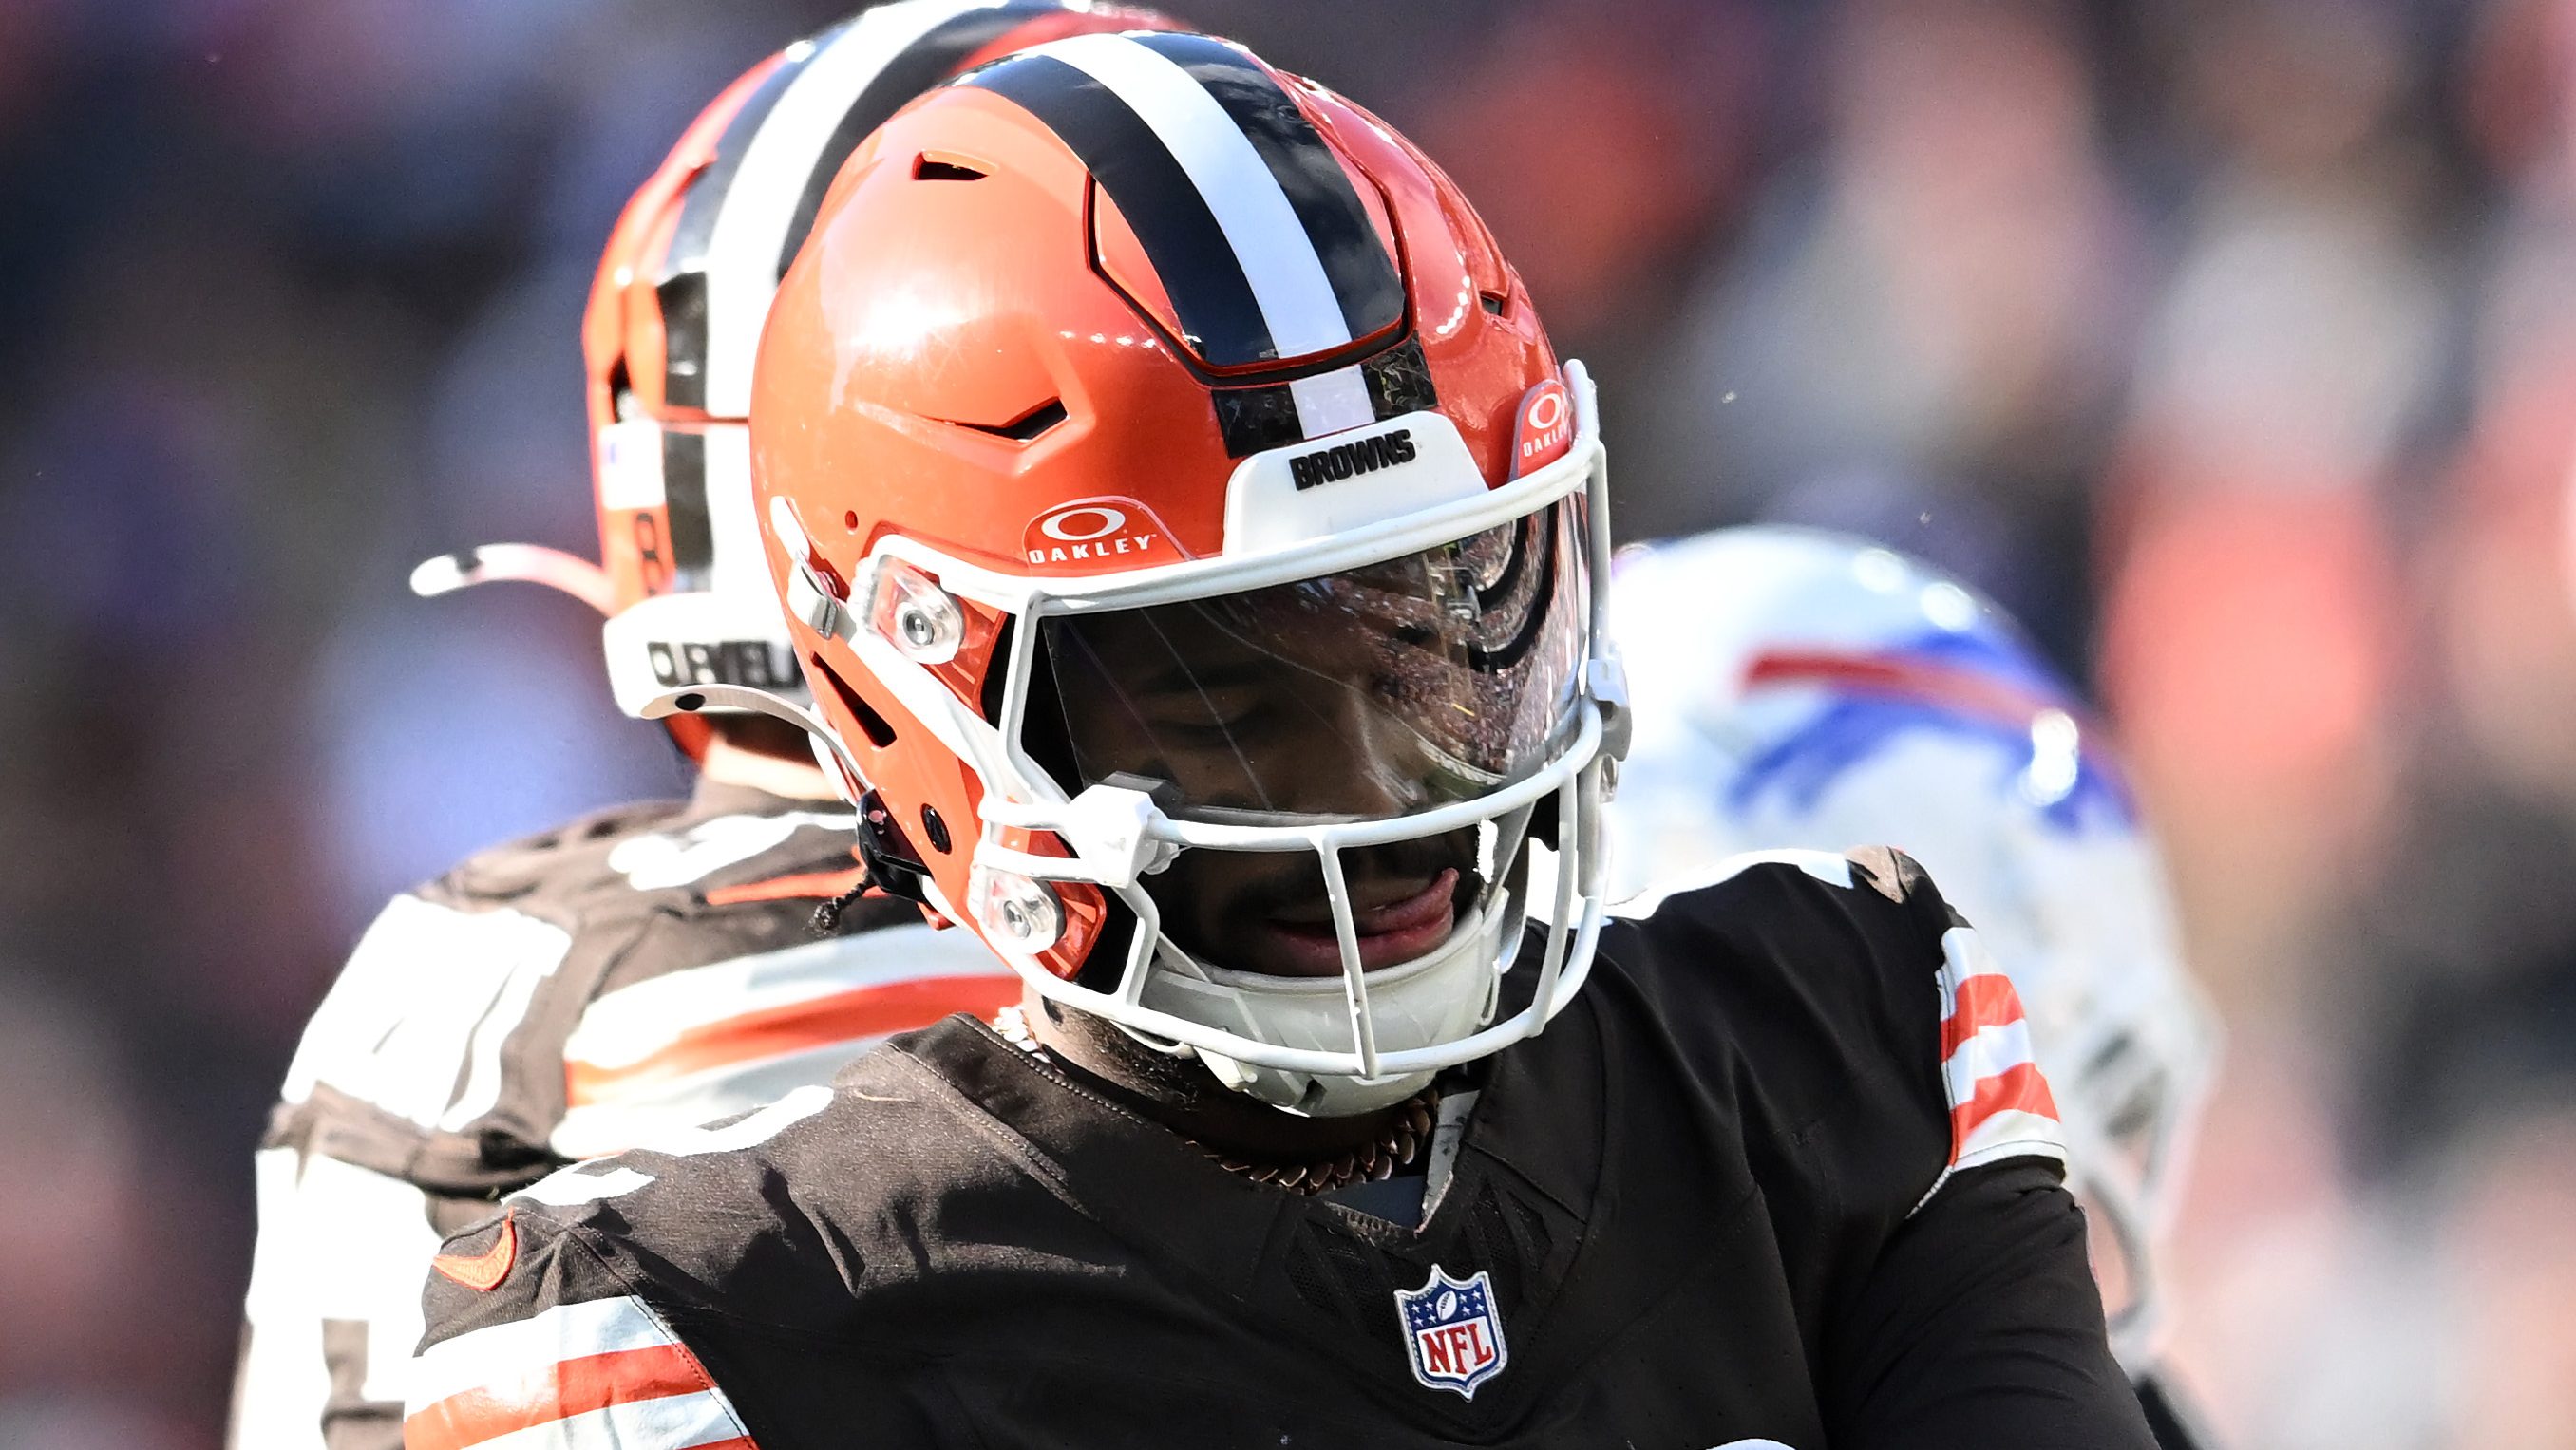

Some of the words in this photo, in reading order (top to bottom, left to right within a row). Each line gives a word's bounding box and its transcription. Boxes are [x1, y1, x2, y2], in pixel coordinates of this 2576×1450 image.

[1289, 429, 1416, 491] BROWNS
[1523, 424, 1569, 457] OAKLE
[1028, 534, 1152, 564] OAKLEY
[647, 639, 806, 687] CLEVEL
[1422, 1323, 1492, 1374] NFL
